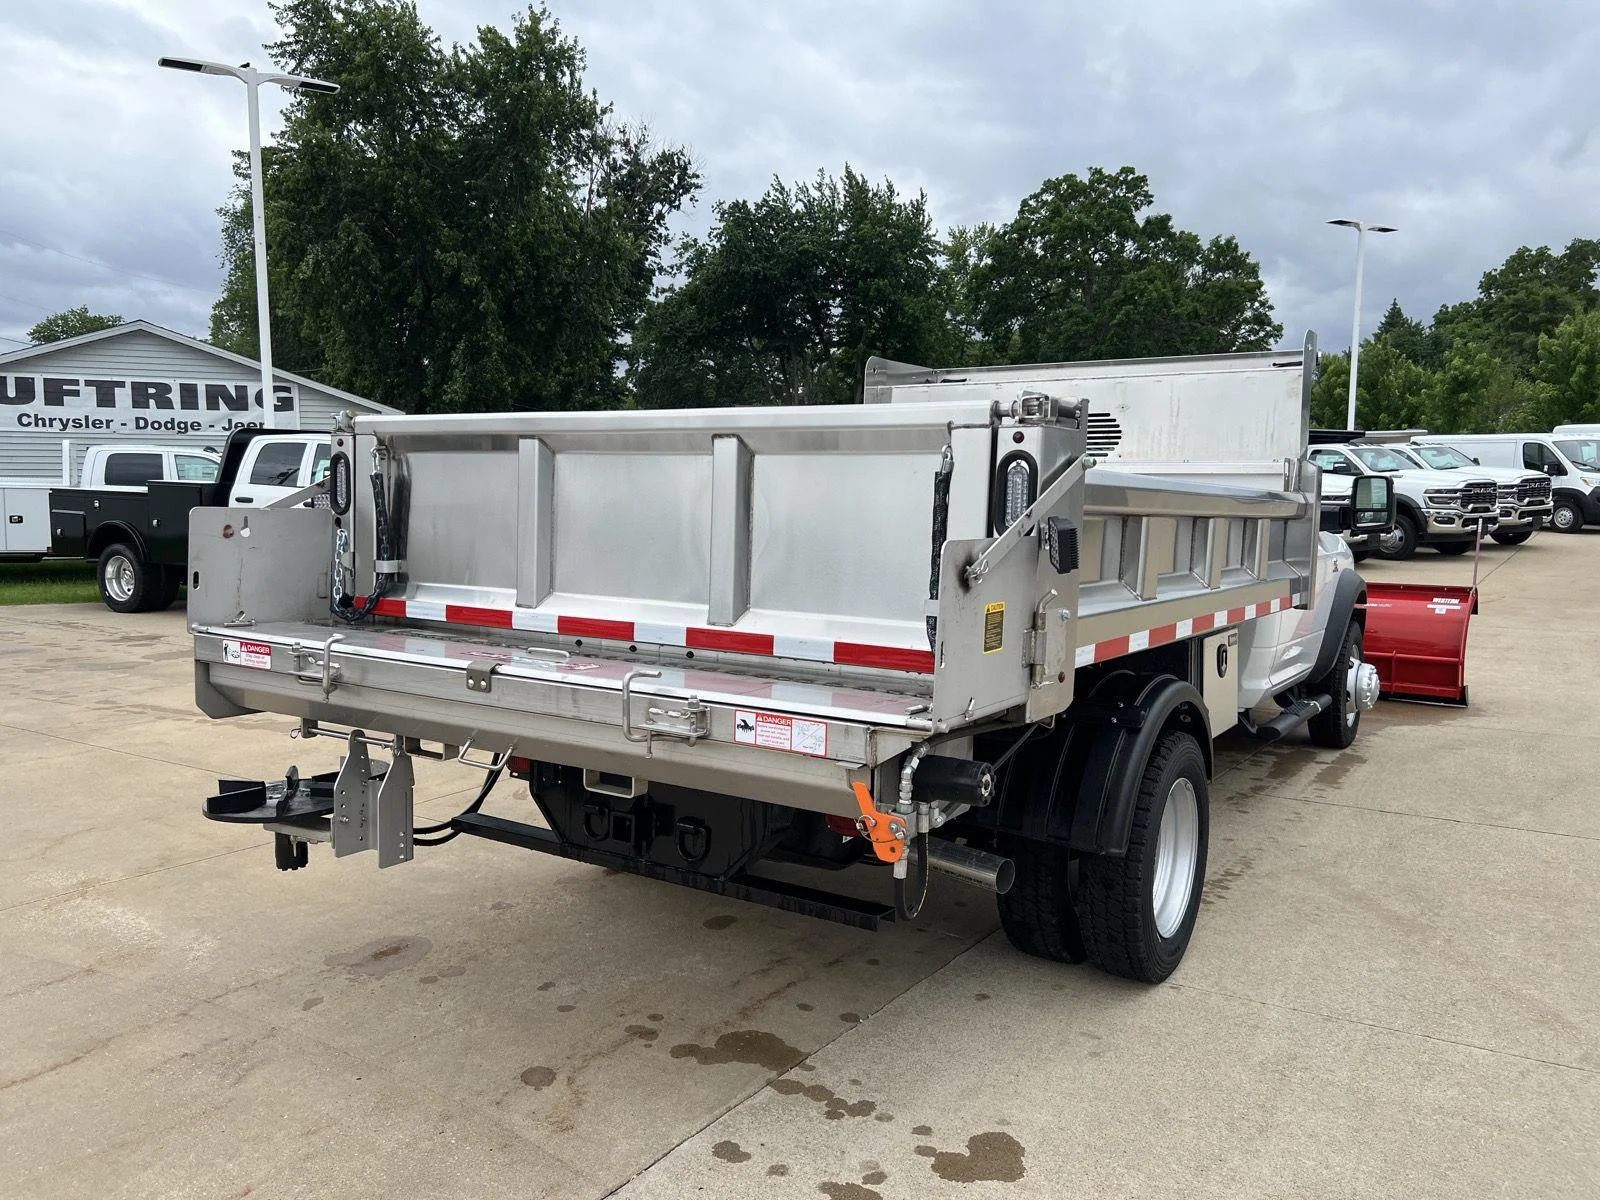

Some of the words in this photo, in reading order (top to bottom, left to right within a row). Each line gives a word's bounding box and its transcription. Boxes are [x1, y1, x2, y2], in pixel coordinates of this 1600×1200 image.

[17, 413, 114, 431] Chrysler
[135, 416, 202, 434] Dodge
[247, 644, 270, 654] DANGER
[763, 716, 791, 726] DANGER
